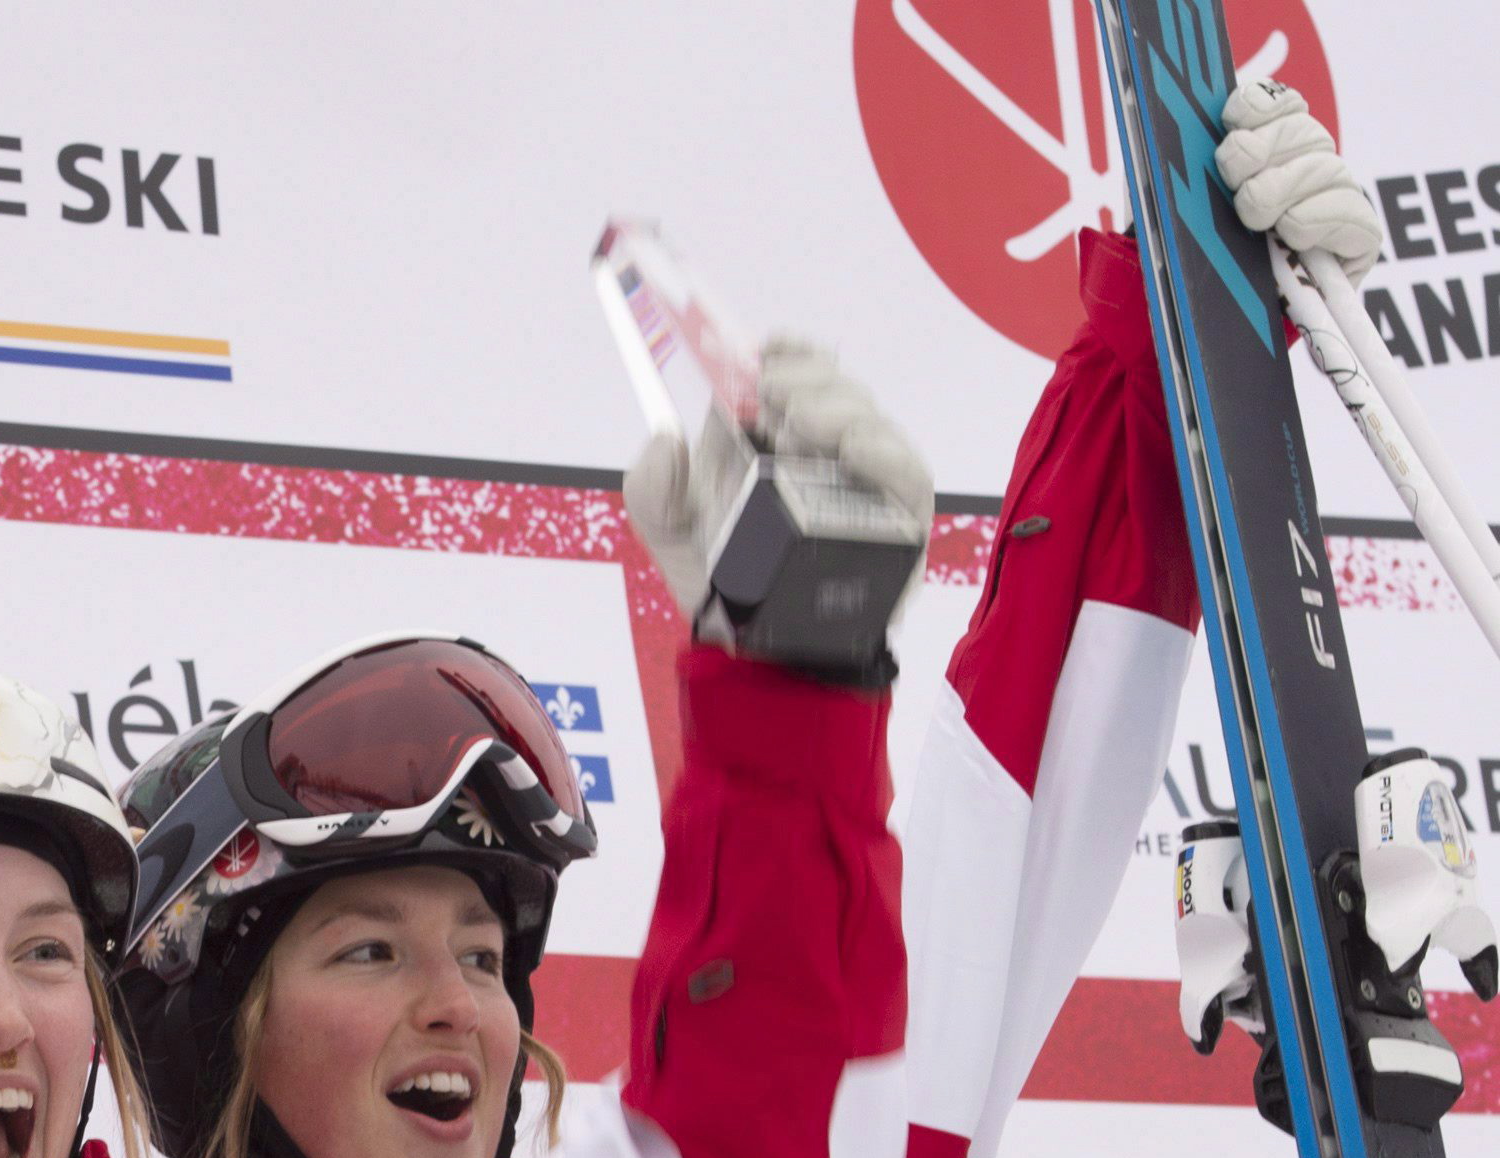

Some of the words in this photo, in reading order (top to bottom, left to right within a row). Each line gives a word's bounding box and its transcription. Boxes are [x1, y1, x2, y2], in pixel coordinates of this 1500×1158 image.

[56, 143, 222, 237] SKI
[1367, 412, 1411, 477] BLISS
[1184, 863, 1195, 916] LOOK
